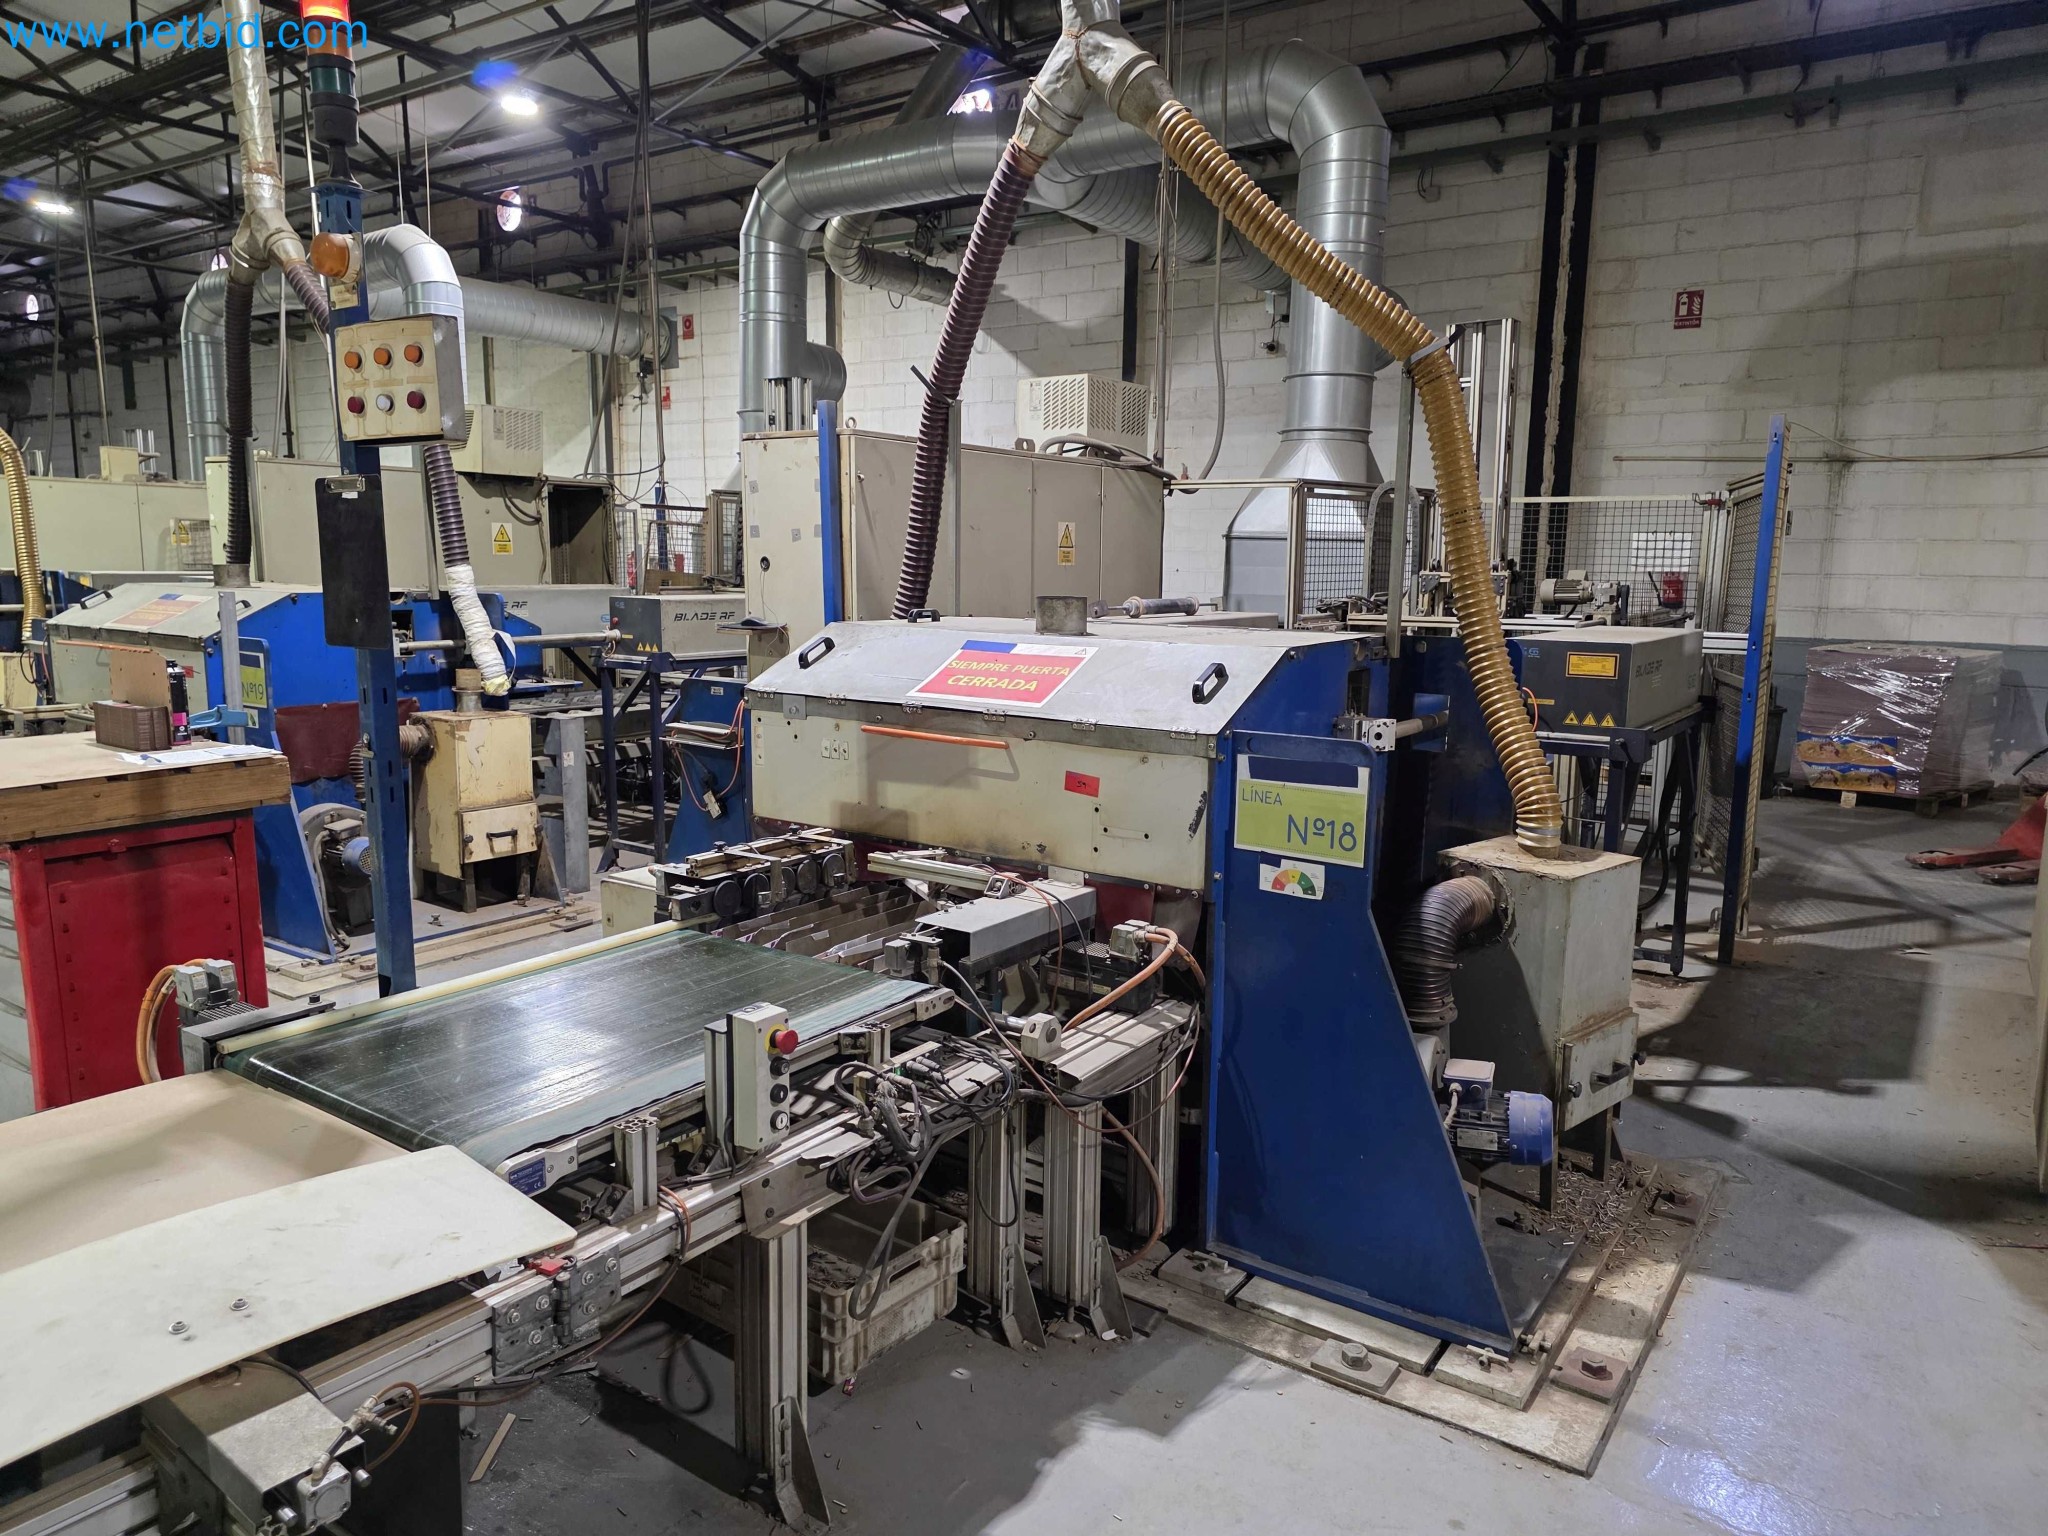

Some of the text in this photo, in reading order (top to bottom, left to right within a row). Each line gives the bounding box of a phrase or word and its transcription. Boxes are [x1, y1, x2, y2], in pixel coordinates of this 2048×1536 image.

[674, 611, 736, 621] BLADE RF
[949, 660, 1070, 676] SIEMPRE PUERTA
[947, 675, 1038, 692] CERRADA
[1242, 785, 1283, 806] LÍNEA
[1287, 814, 1357, 852] Nº18
